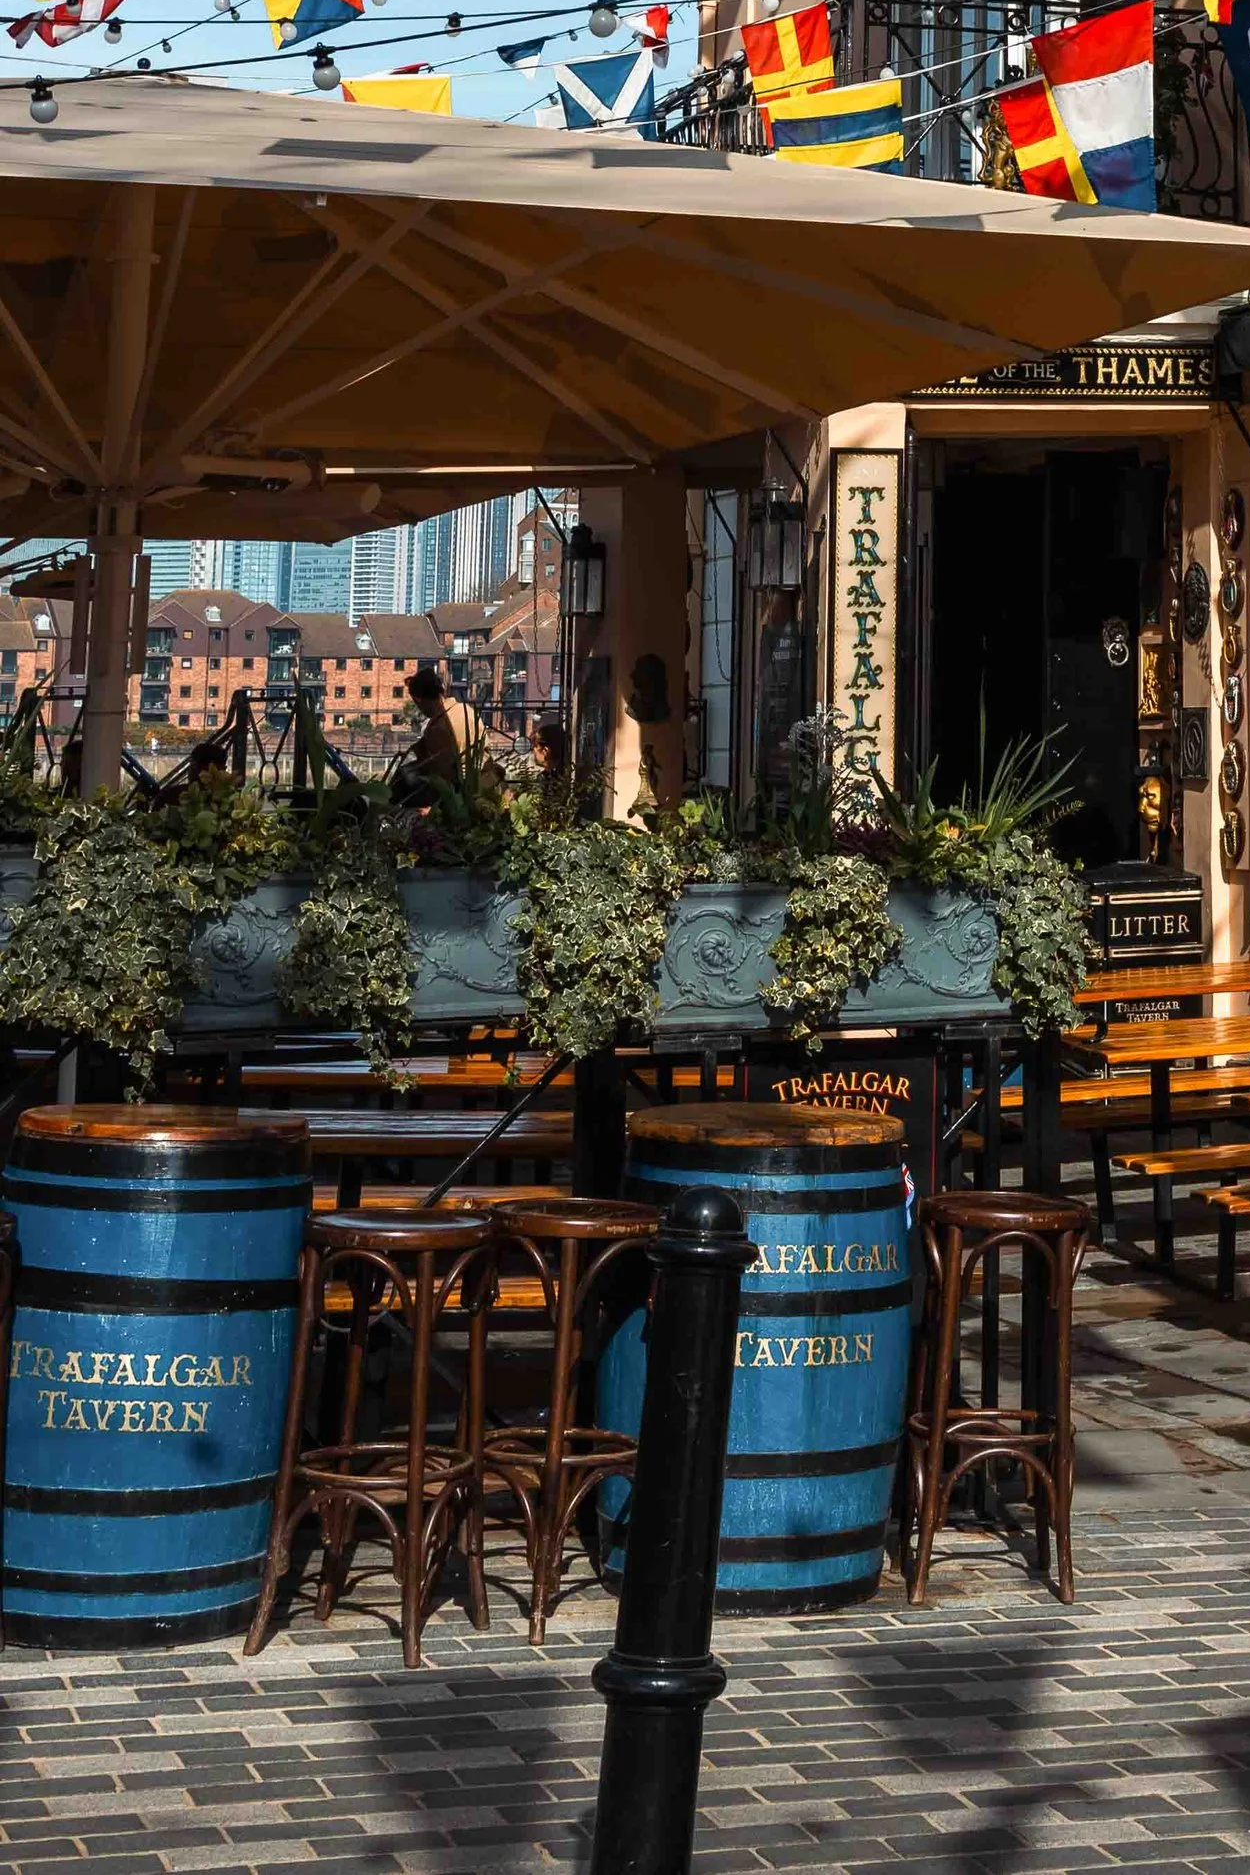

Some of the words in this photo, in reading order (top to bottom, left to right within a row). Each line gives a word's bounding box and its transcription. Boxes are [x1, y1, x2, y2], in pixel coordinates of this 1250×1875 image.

[993, 363, 1016, 380] OF
[1020, 362, 1057, 380] THE
[1072, 356, 1217, 387] THAMES
[1110, 914, 1191, 937] LITTER
[1115, 1000, 1181, 1014] TRAFALGAR
[1126, 1011, 1170, 1024] TAVERN
[771, 1071, 911, 1102] TRAFALGAR
[746, 1242, 901, 1274] AFALGAR
[9, 1340, 254, 1388] TRAFALGAR
[734, 1331, 874, 1367] TAVERN
[38, 1389, 213, 1434] TAVERN
